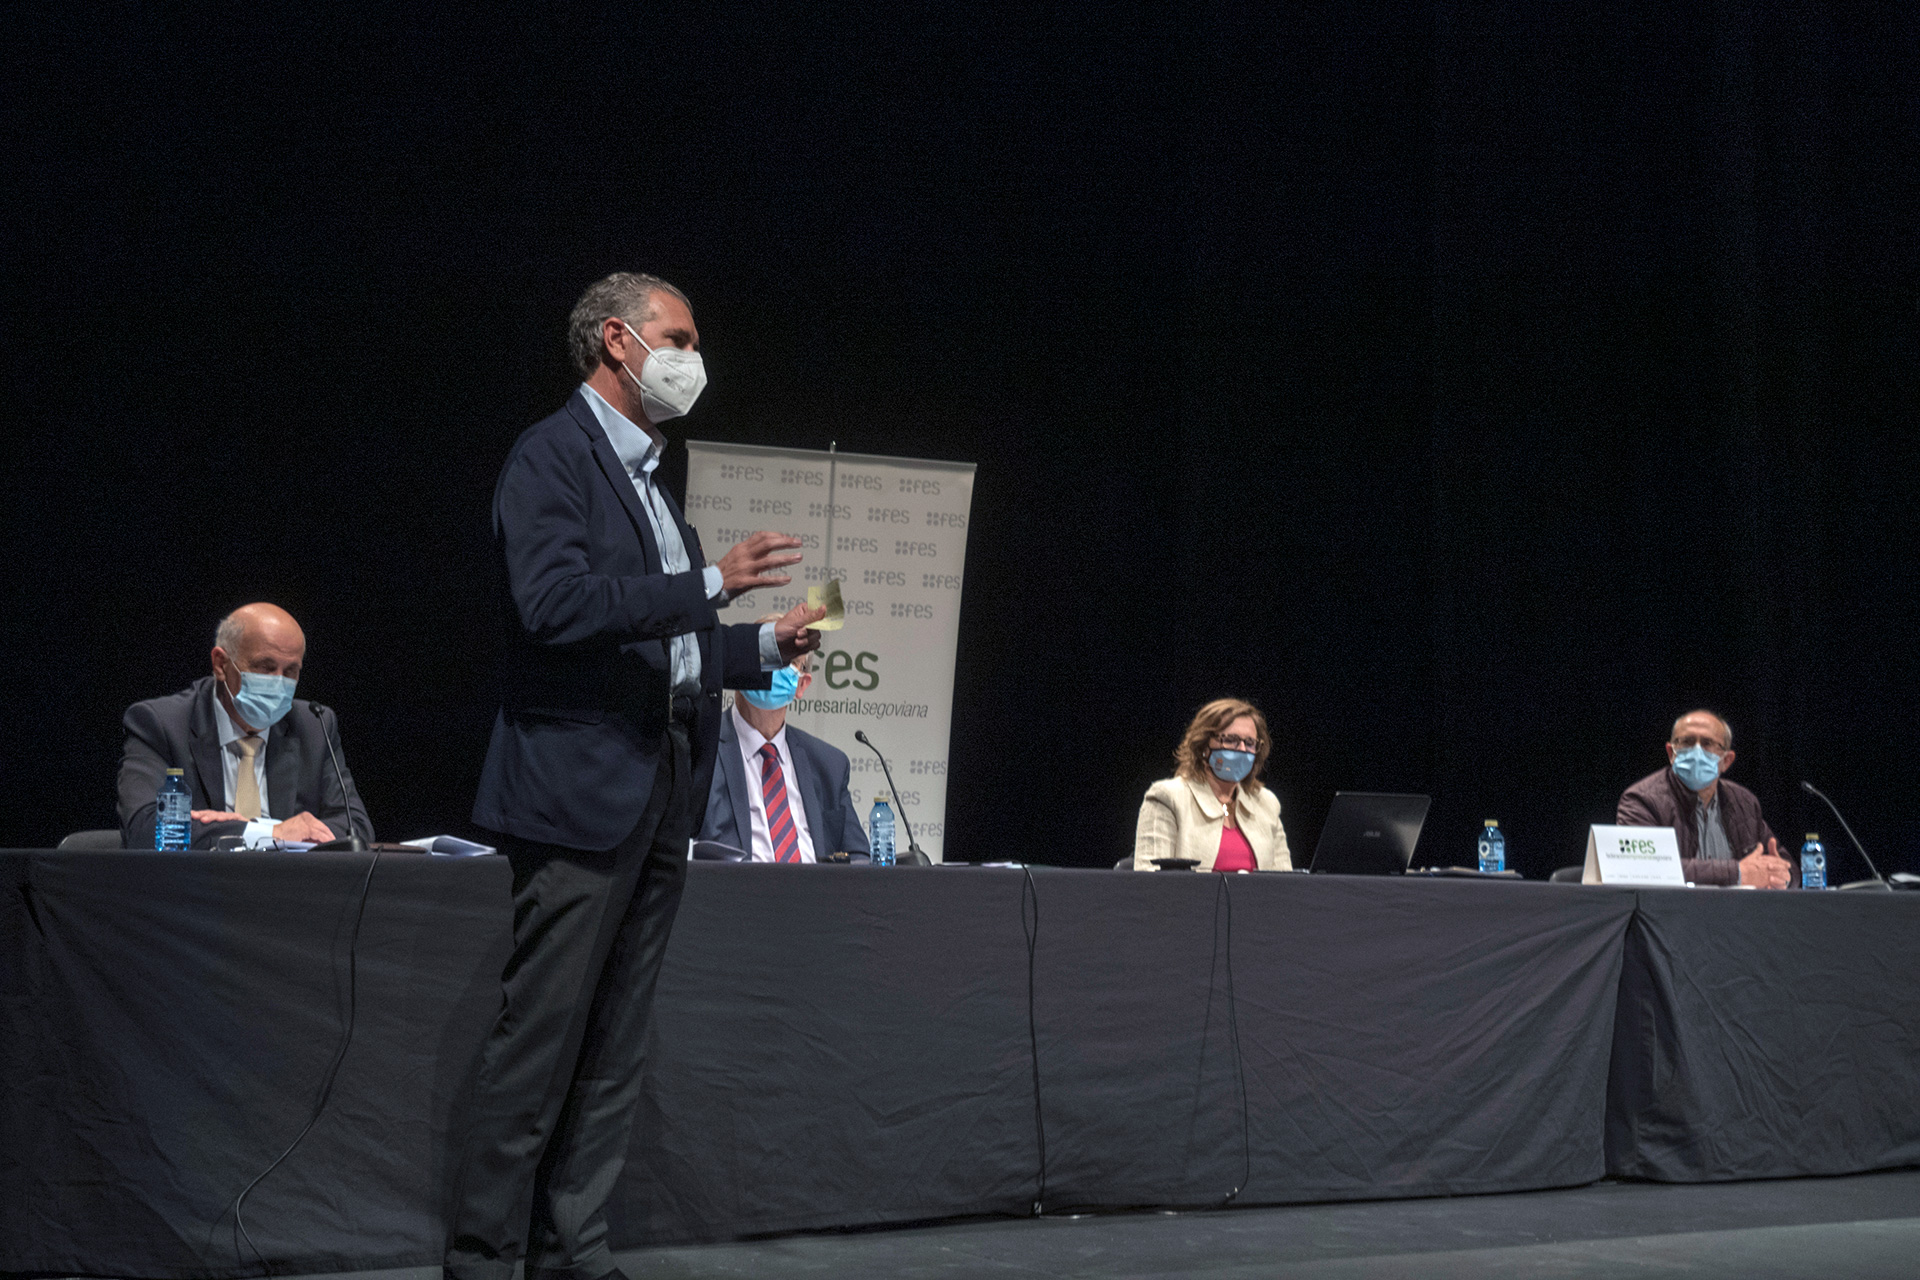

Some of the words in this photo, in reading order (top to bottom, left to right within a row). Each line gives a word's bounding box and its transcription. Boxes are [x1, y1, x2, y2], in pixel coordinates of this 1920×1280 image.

[735, 465, 764, 482] fes
[795, 470, 823, 486] fes
[855, 475, 882, 491] fes
[913, 480, 941, 495] fes
[703, 495, 732, 511] fes
[763, 499, 792, 516] fes
[823, 503, 851, 520] fes
[881, 508, 910, 524] fes
[940, 512, 966, 529] fes
[732, 529, 757, 544] fe
[793, 532, 820, 549] es
[850, 537, 878, 553] fes
[909, 541, 937, 557] fes
[818, 566, 847, 583] fes
[877, 570, 906, 587] fes
[935, 574, 960, 590] fes
[846, 600, 874, 616] fes
[904, 603, 933, 620] fes
[924, 760, 946, 775] fes
[920, 822, 943, 837] fes
[1631, 839, 1656, 854] fes
